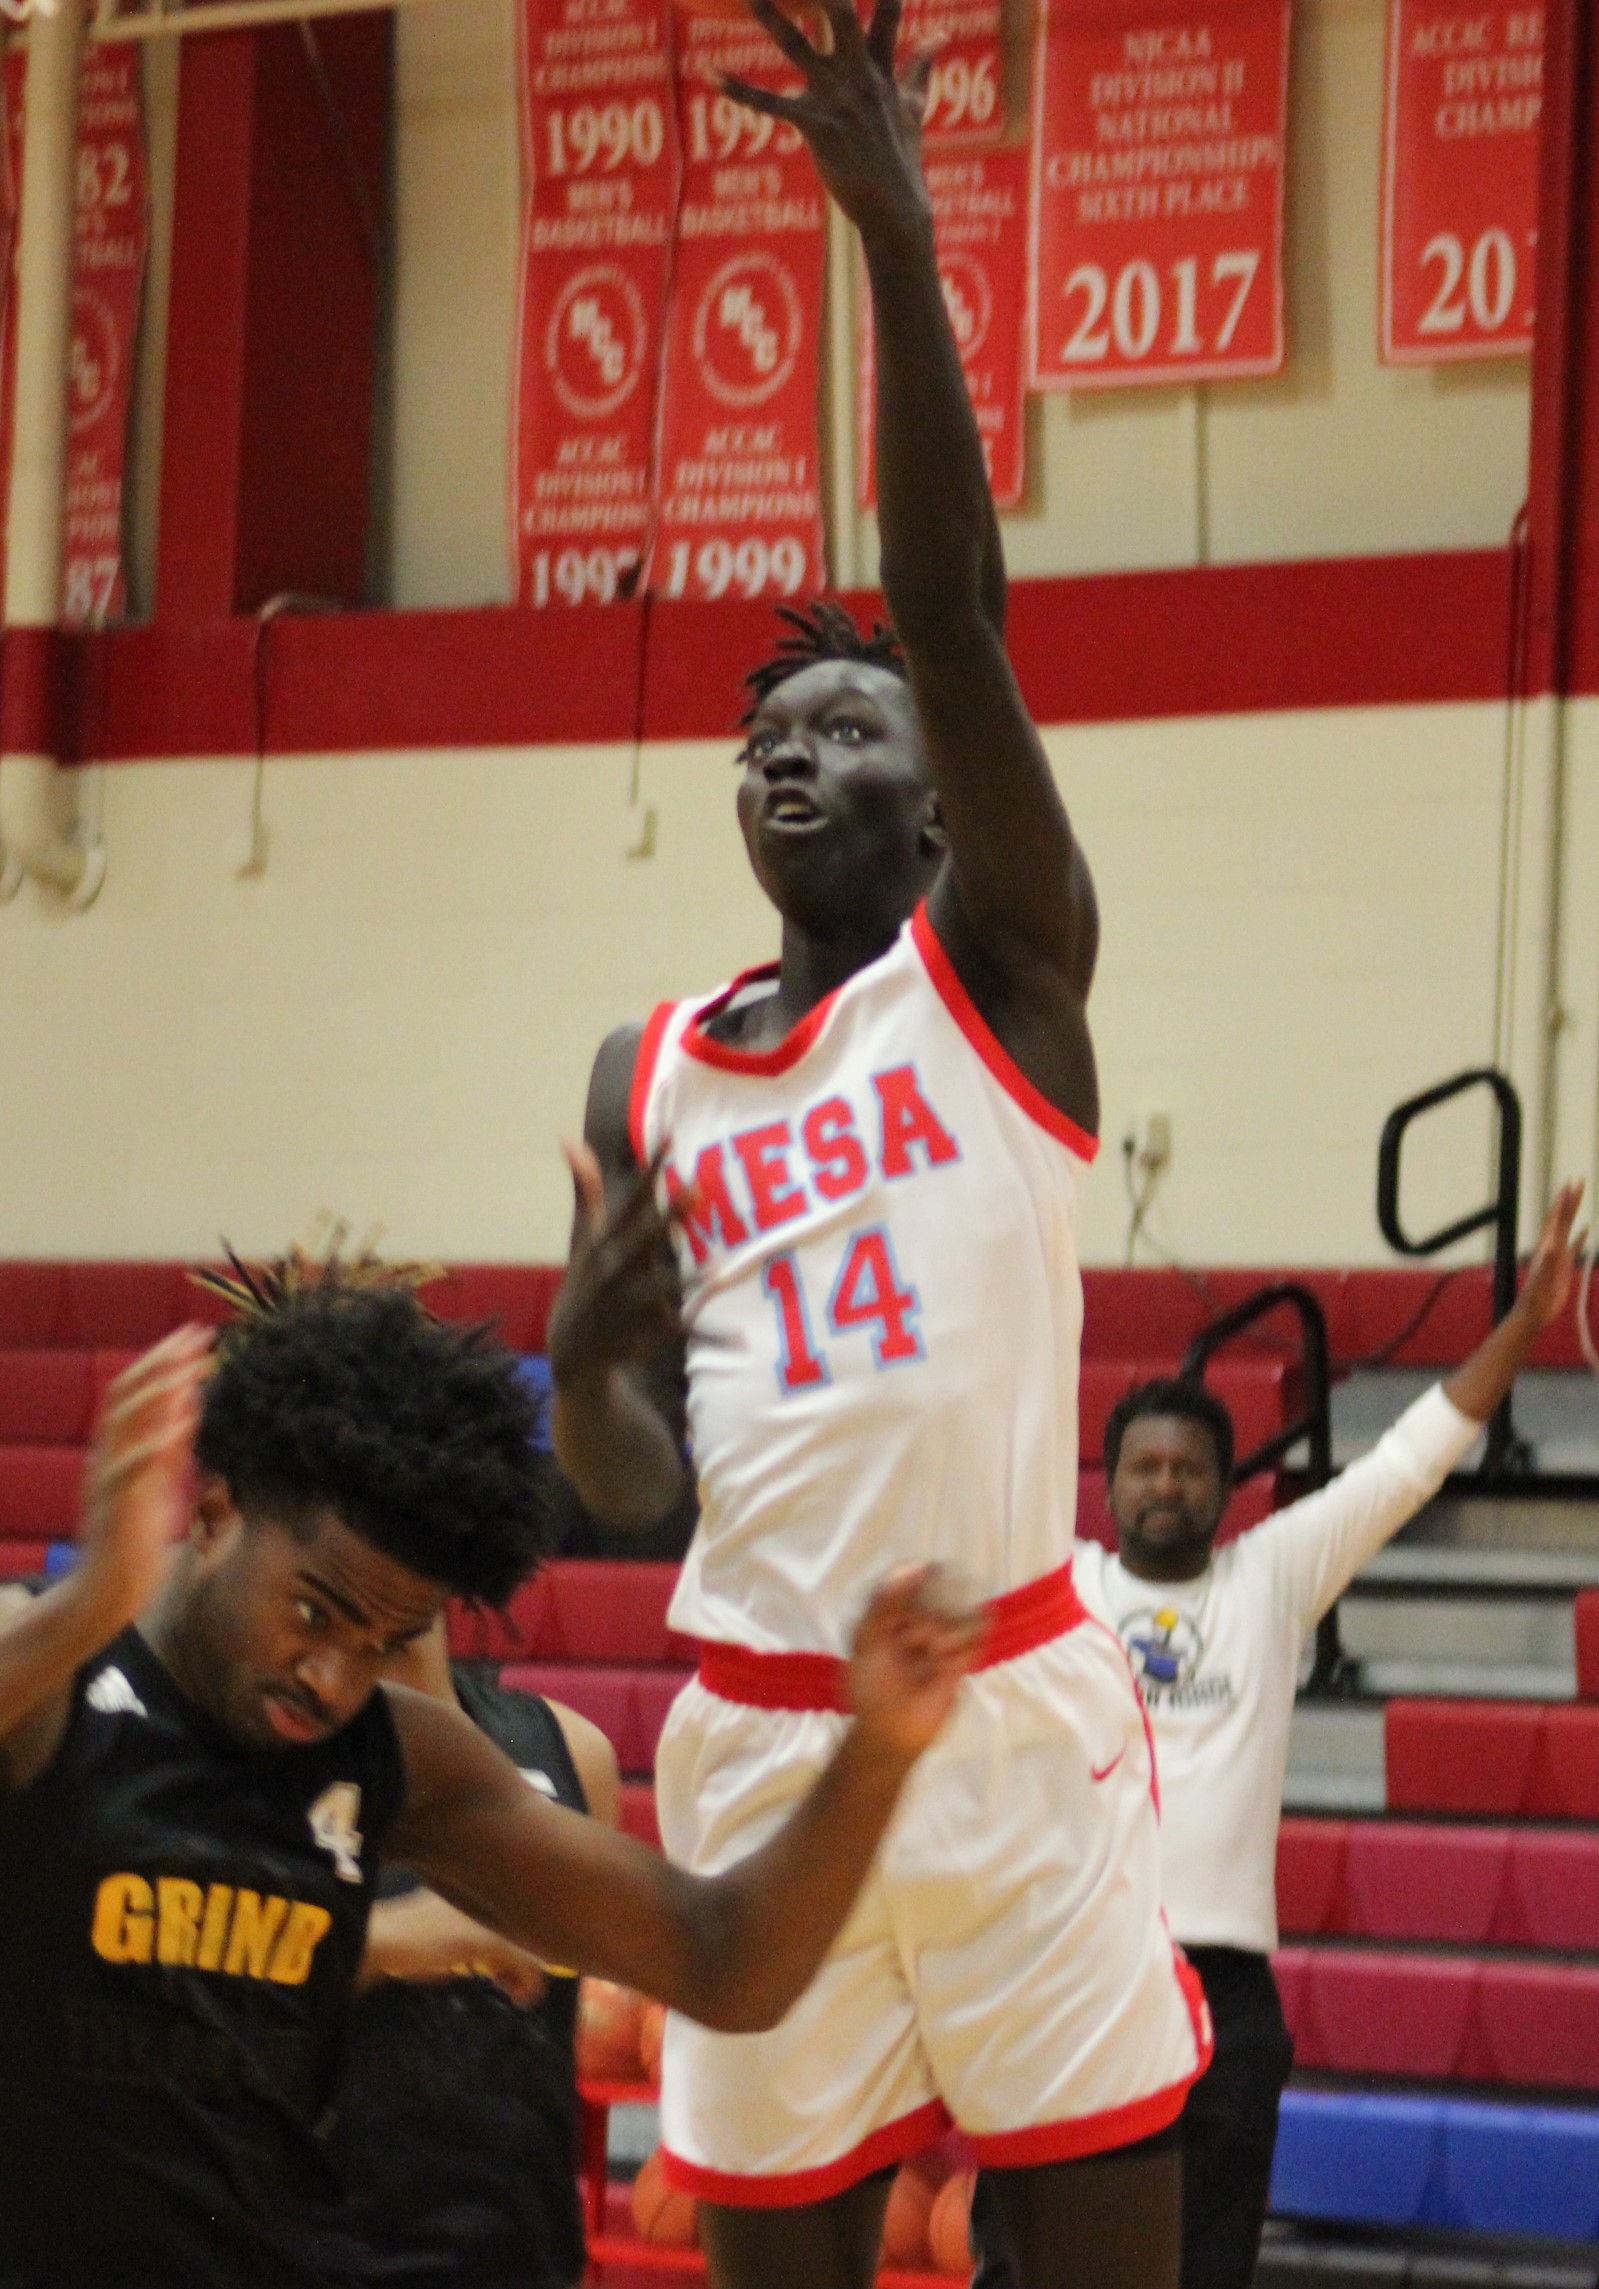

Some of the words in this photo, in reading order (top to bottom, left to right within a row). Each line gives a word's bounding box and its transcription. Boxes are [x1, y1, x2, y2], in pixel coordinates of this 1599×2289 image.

[547, 97, 664, 177] 1990
[1097, 98, 1237, 144] NATIONAL
[1060, 248, 1261, 364] 2017
[1416, 226, 1538, 336] 20
[666, 536, 807, 600] 1999
[664, 1061, 964, 1268] MESA
[762, 1218, 928, 1396] 14
[308, 1781, 364, 1884] 4
[92, 1872, 332, 1986] GRIND
